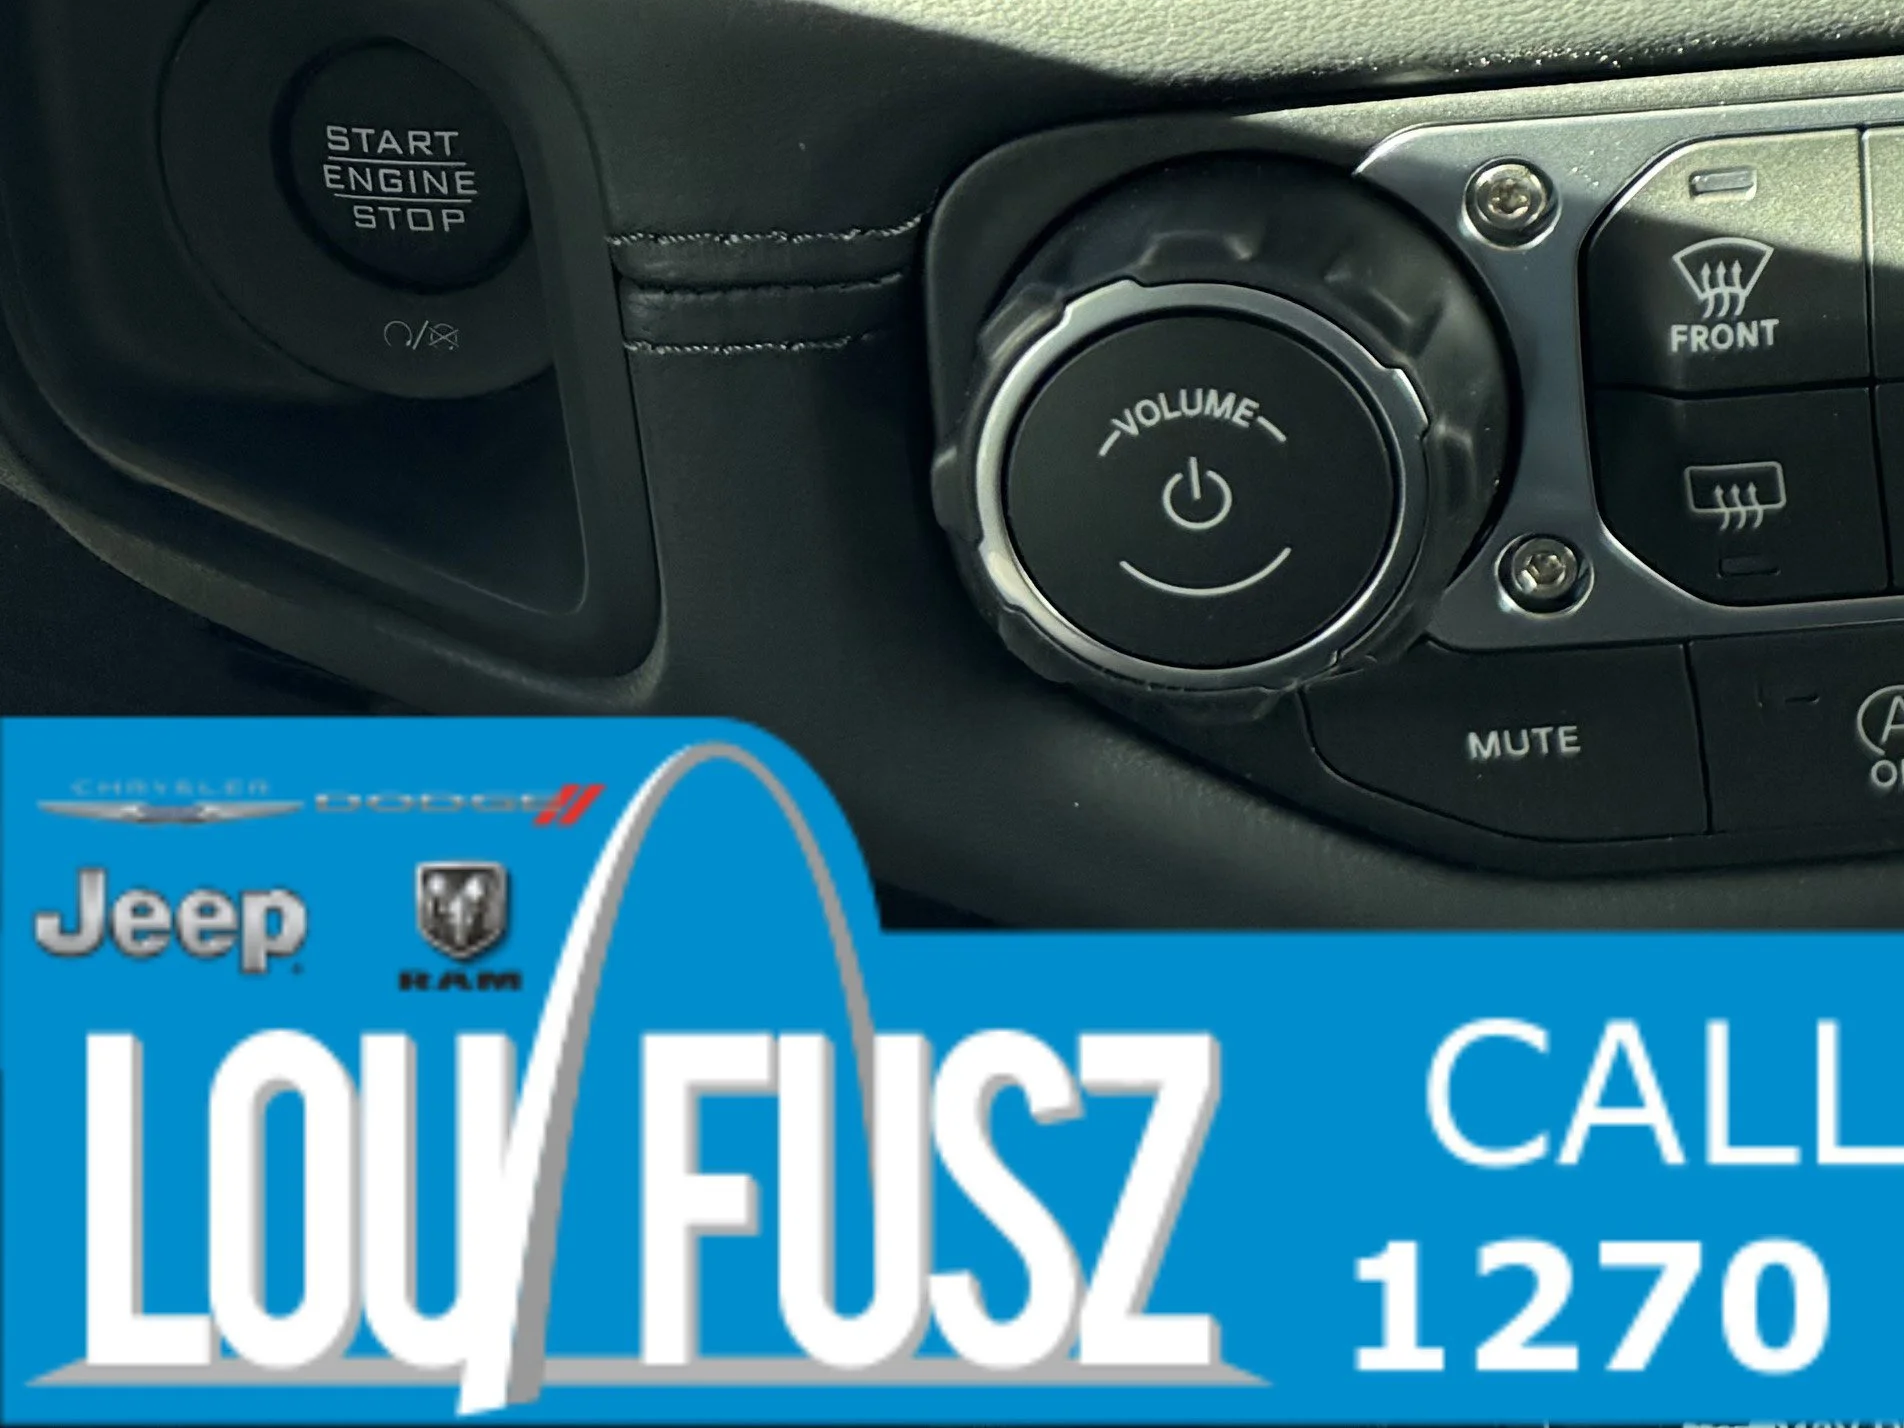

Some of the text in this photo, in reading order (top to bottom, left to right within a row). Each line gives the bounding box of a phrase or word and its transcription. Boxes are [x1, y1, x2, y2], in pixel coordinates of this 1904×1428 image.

[326, 125, 459, 156] START
[323, 164, 478, 196] ENGINE
[354, 205, 465, 232] STOP
[1670, 318, 1780, 353] FRONT
[1110, 388, 1260, 438] VOLUME
[1468, 725, 1581, 761] MUTE
